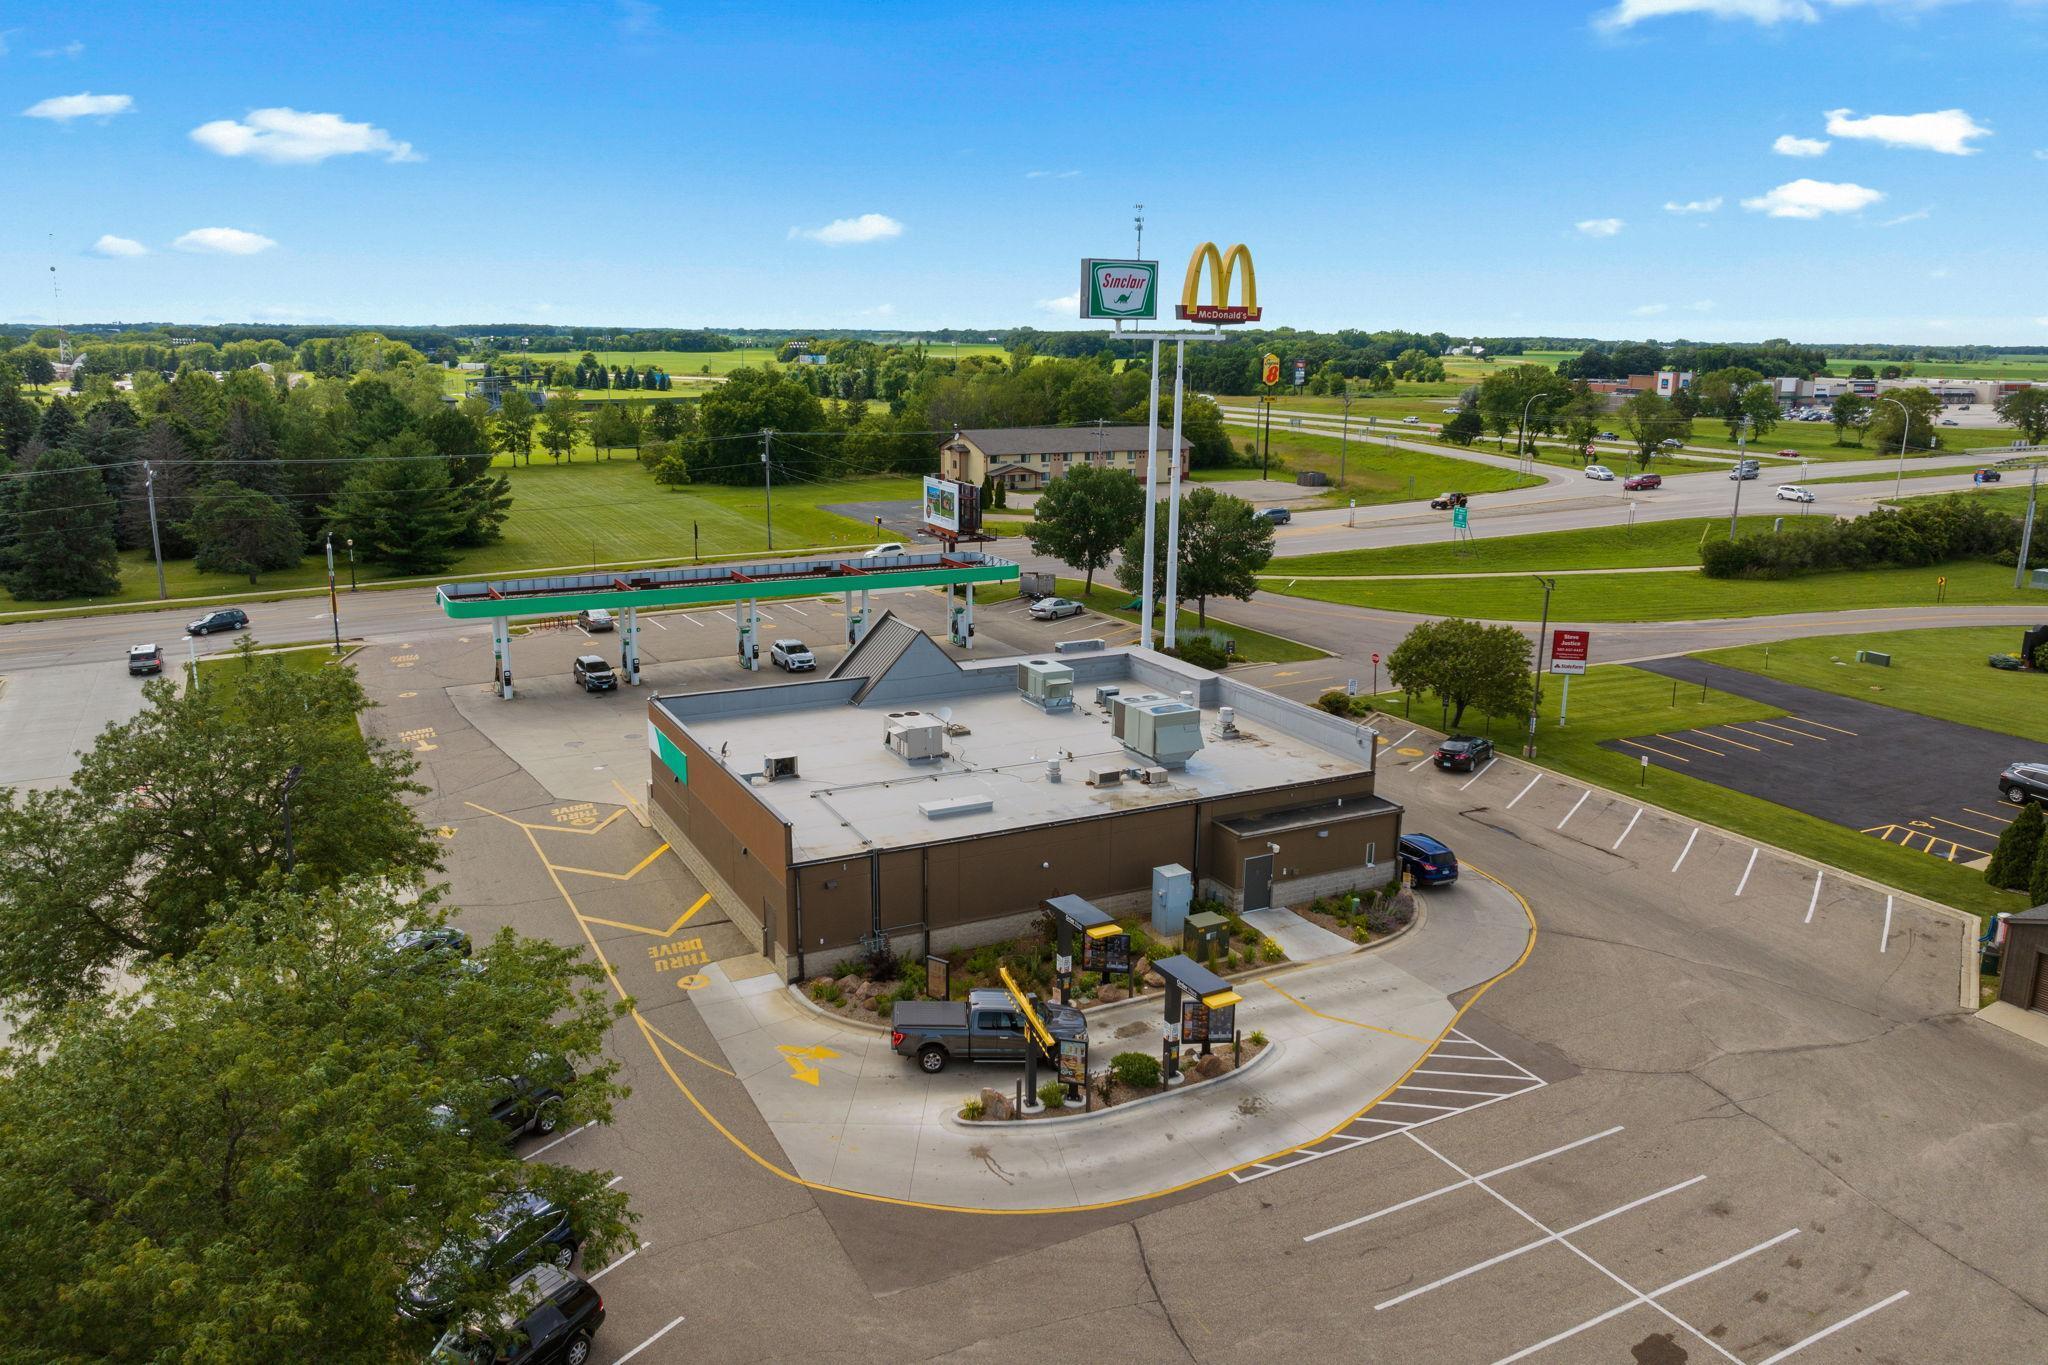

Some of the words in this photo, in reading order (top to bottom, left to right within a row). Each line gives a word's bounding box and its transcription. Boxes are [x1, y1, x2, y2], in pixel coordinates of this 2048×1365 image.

[1103, 273, 1146, 289] Sinclair
[1199, 310, 1248, 320] McDonald's
[1266, 365, 1279, 384] 8
[551, 803, 594, 816] DRIVE
[556, 809, 599, 822] THRU
[648, 938, 703, 958] DRIVE
[654, 951, 711, 972] THRU
